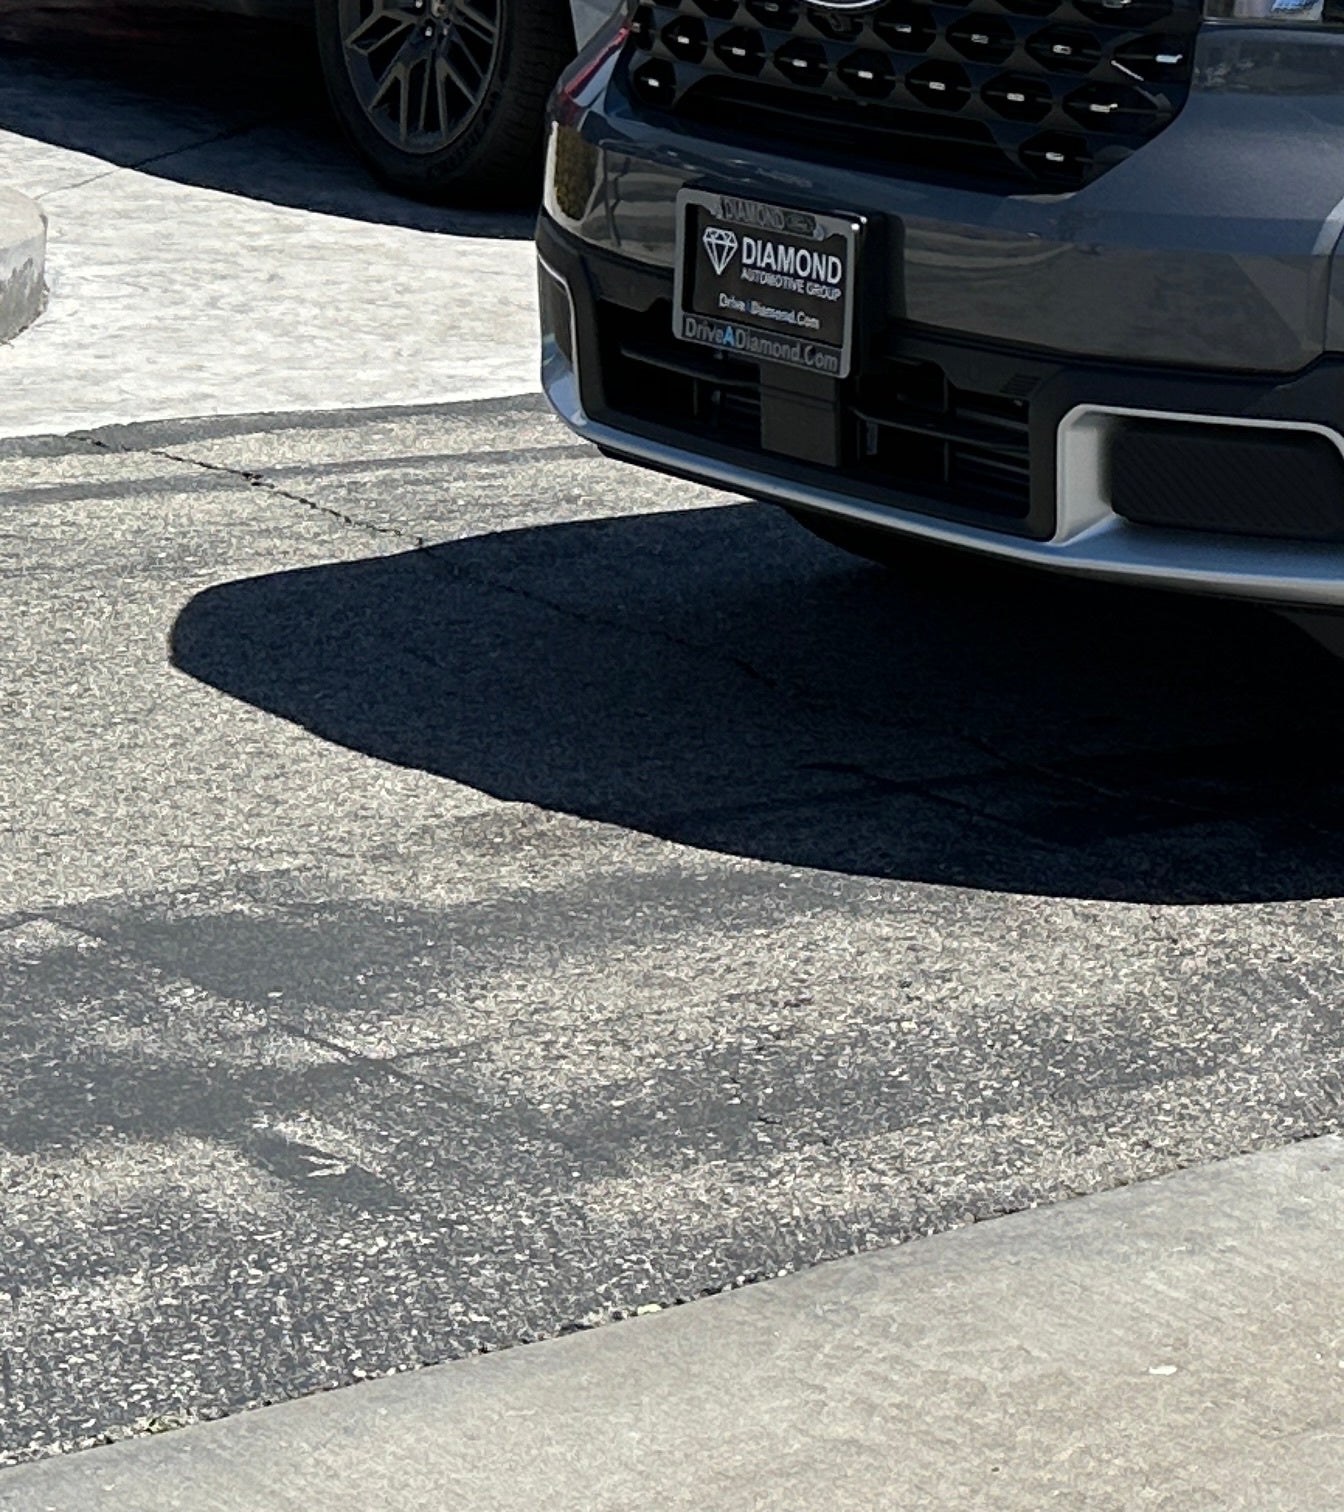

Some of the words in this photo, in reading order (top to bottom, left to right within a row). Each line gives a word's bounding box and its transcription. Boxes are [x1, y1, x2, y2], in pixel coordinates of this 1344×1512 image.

[742, 237, 842, 284] DIAMOND
[741, 271, 804, 294] AUTOMOTIVE
[806, 283, 842, 301] GROUP
[685, 317, 838, 372] DriveADiamond.Com
